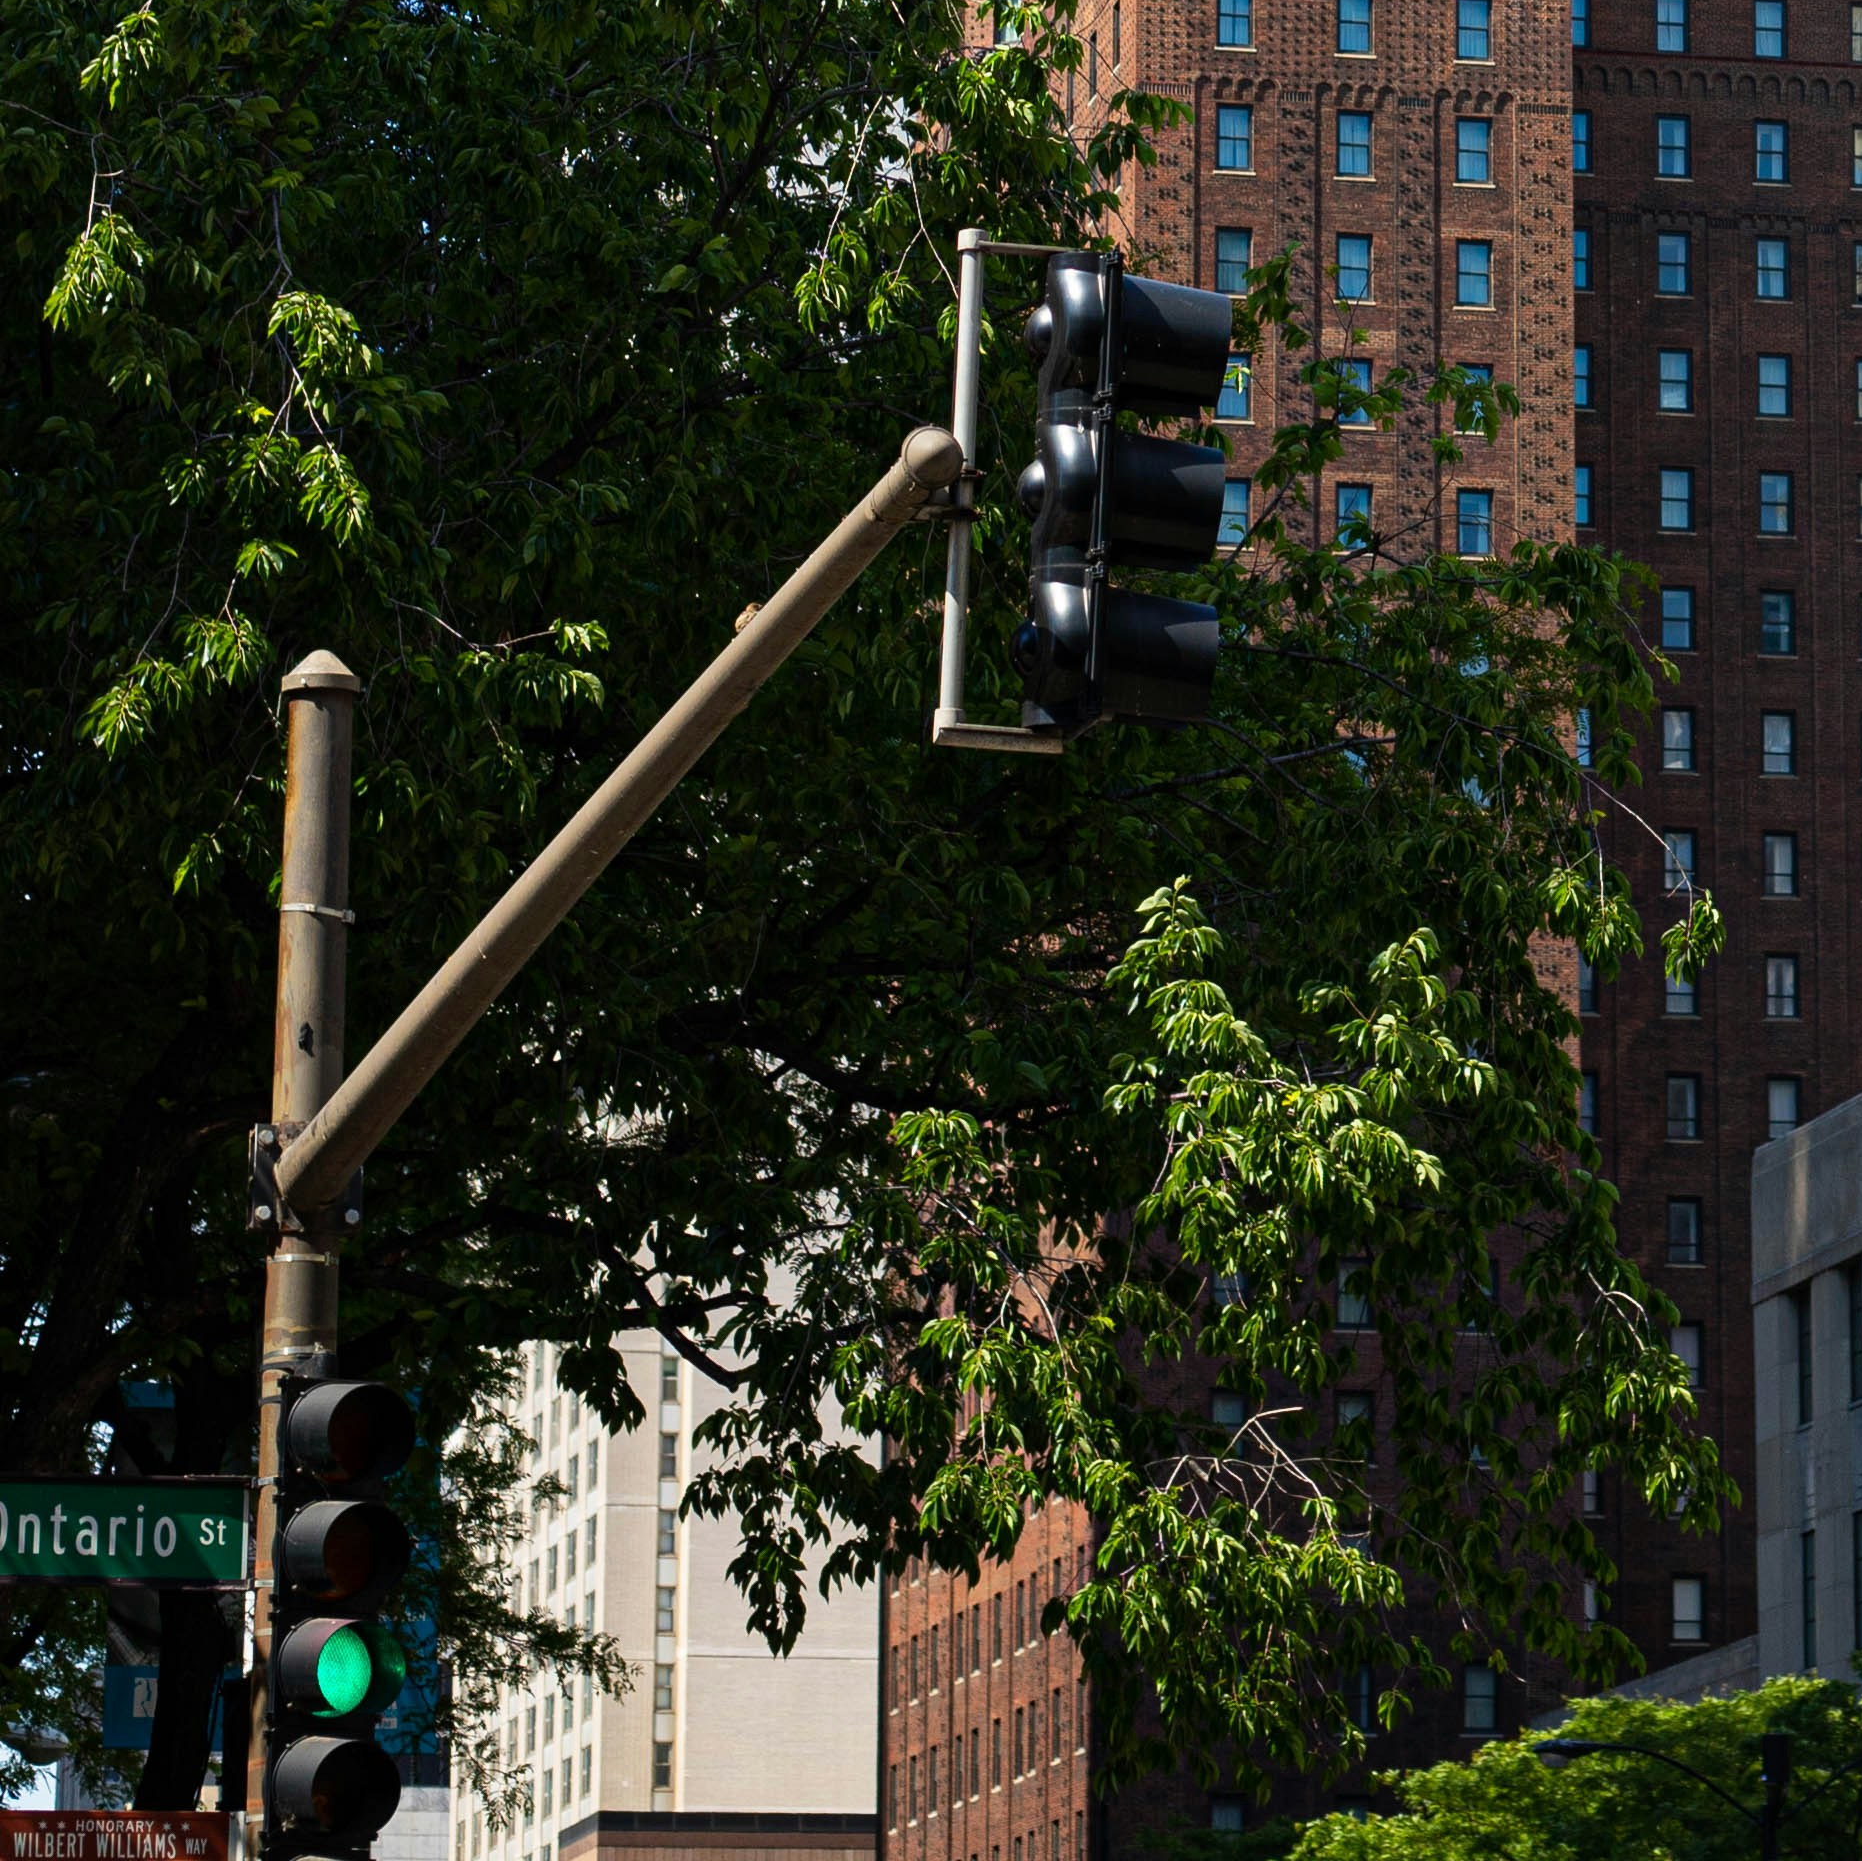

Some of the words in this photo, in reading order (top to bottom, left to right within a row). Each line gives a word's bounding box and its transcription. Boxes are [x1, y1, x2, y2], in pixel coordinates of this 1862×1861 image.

[199, 1517, 227, 1547] St
[75, 1819, 155, 1833] HONORARY
[14, 1832, 86, 1858] WILBERT
[96, 1833, 177, 1860] WILLIAMS
[185, 1838, 208, 1855] WAY
